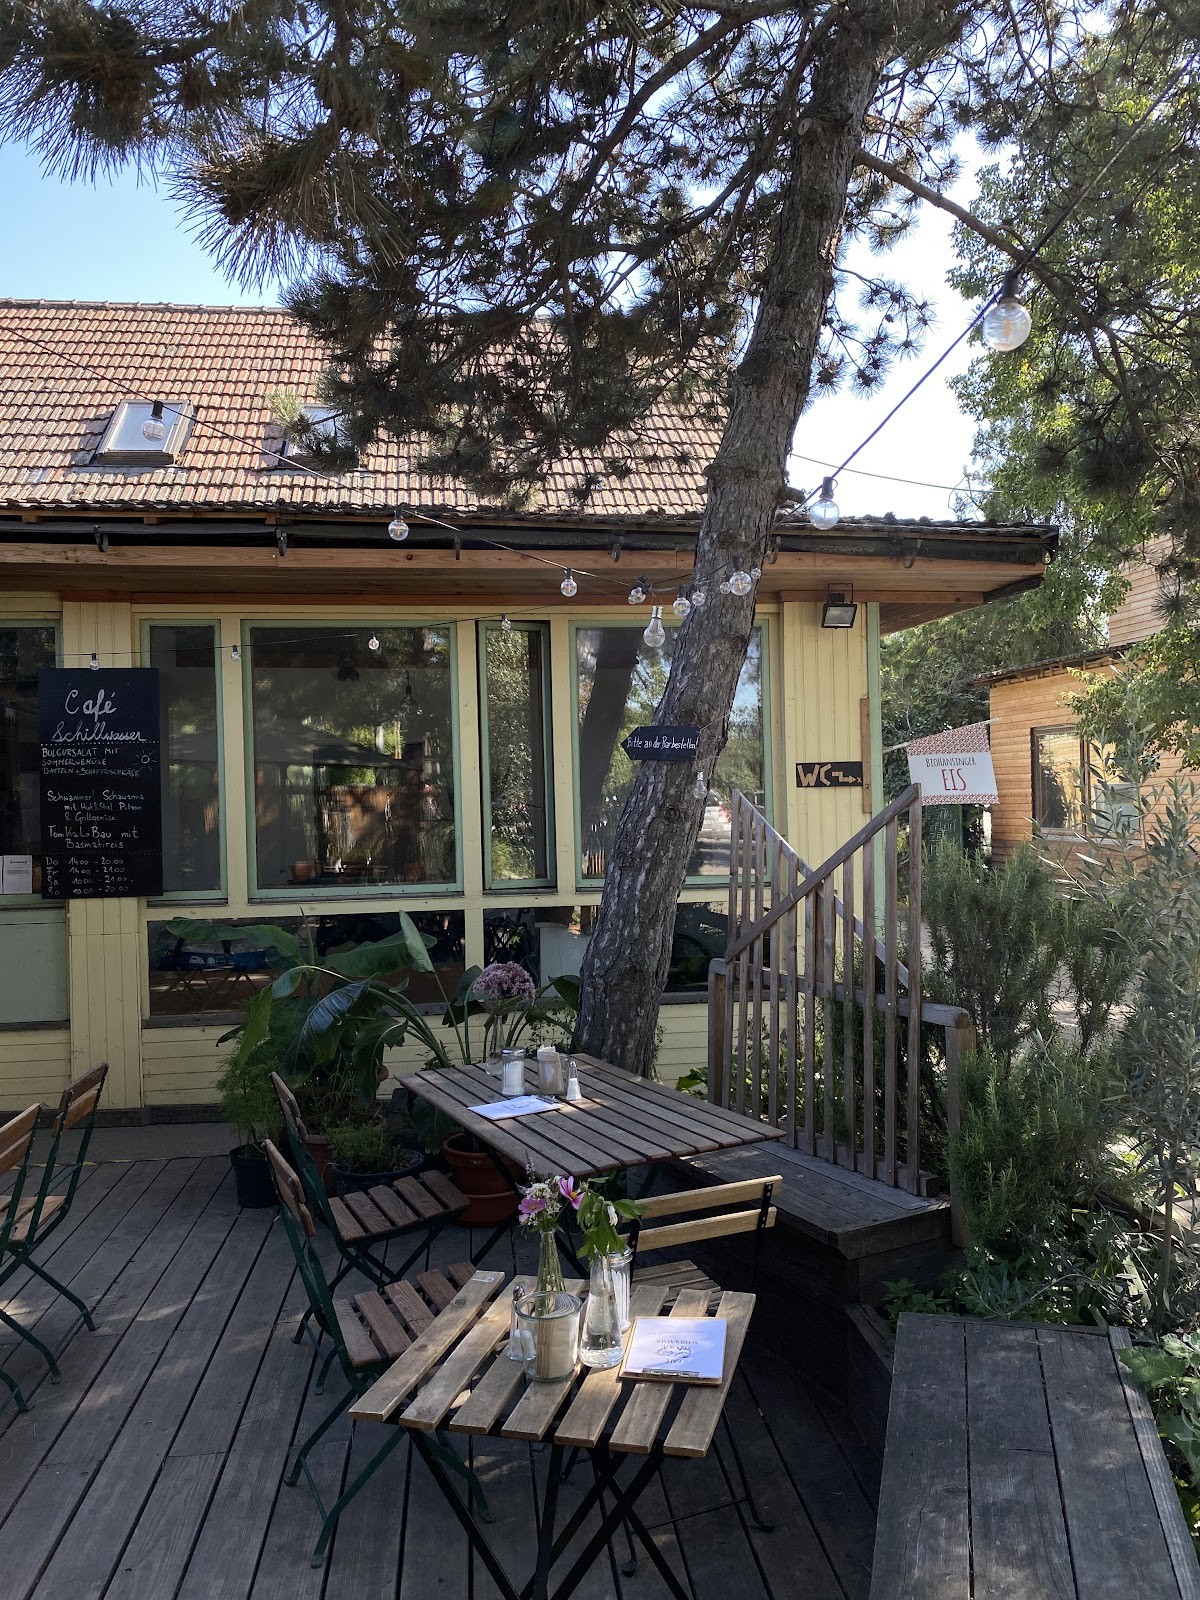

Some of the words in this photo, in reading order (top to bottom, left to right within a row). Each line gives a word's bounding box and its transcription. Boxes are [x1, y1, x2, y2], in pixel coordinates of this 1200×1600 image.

[65, 689, 117, 722] Café
[51, 721, 147, 742] Schillwasser
[627, 736, 643, 748] Bitte
[797, 763, 832, 787] WC
[941, 768, 967, 791] EIS
[64, 803, 77, 811] mit
[121, 825, 139, 838] mit
[65, 838, 124, 849] Basmatireis
[45, 856, 59, 865] Do
[45, 867, 59, 875] Fr
